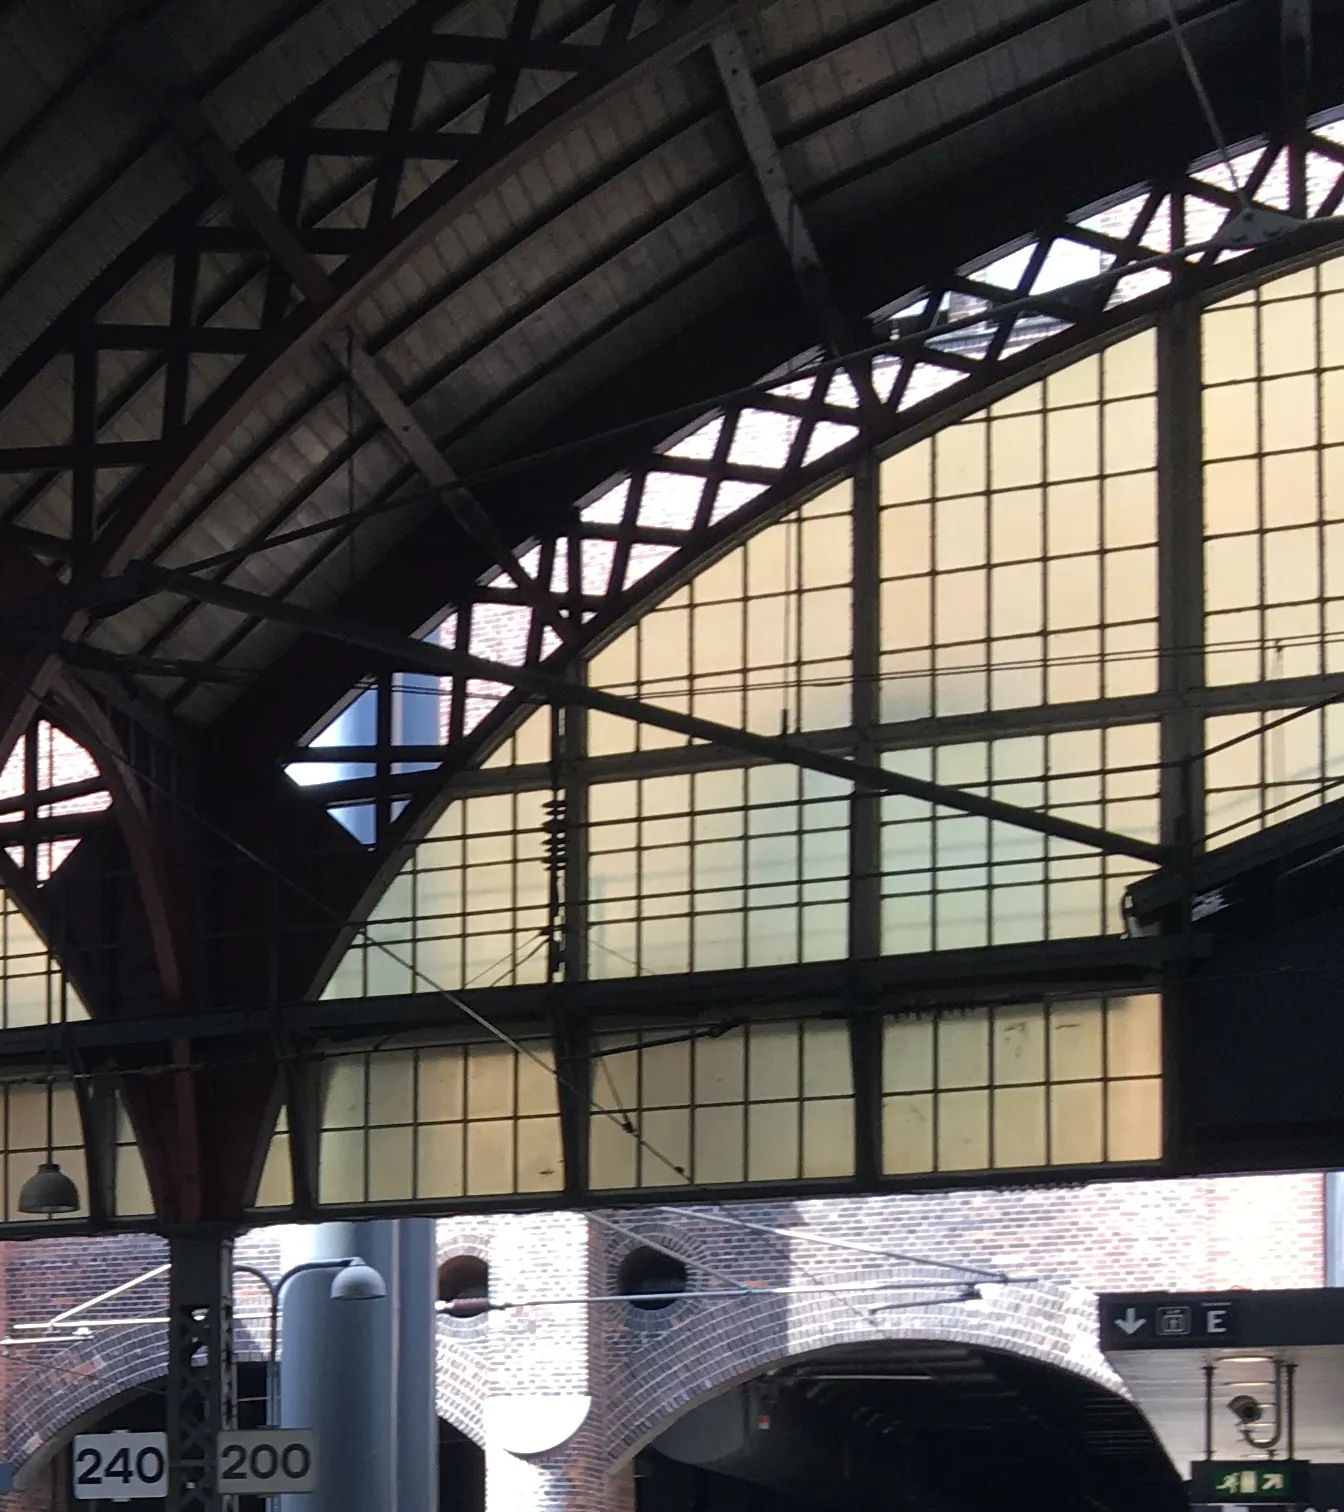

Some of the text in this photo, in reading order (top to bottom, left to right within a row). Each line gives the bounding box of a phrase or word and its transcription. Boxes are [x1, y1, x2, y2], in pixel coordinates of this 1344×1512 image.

[1207, 1310, 1228, 1333] E
[76, 1447, 165, 1485] 240
[221, 1444, 310, 1480] 200
